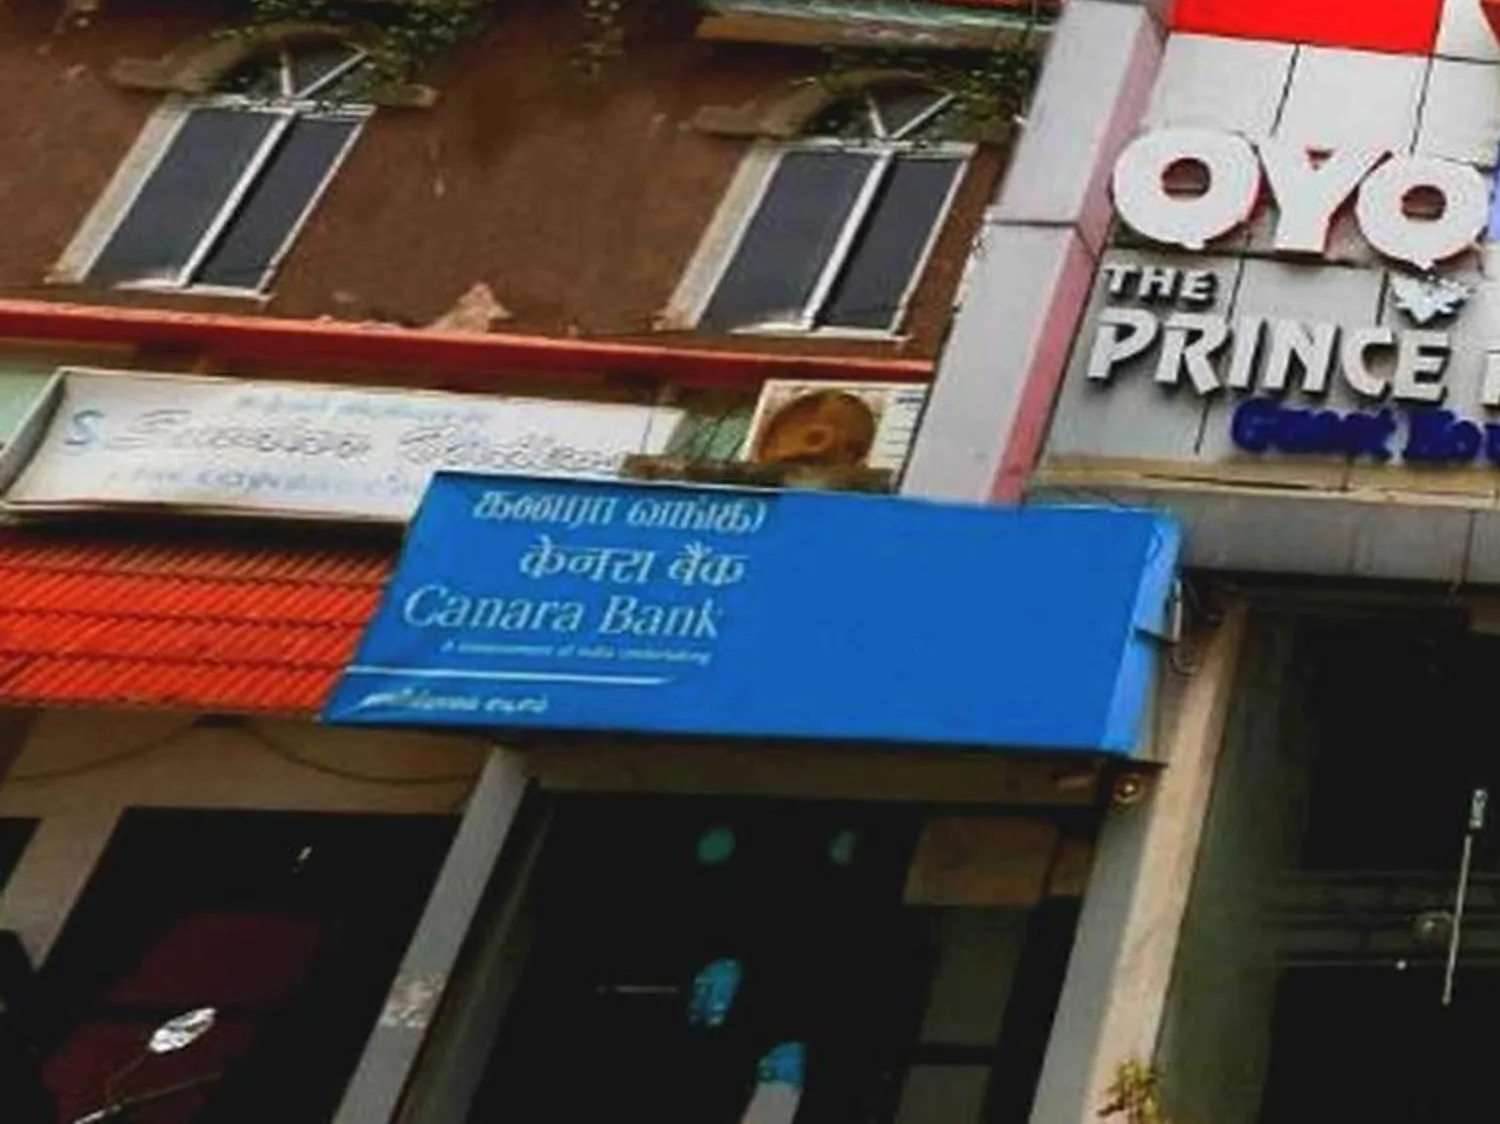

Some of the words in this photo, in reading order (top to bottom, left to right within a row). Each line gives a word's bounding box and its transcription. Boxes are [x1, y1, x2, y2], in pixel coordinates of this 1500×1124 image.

[1112, 129, 1490, 273] OYO
[1104, 265, 1218, 303] THE
[1087, 308, 1453, 403] PRINCE
[404, 584, 582, 633] Canara
[600, 595, 719, 639] Bank
